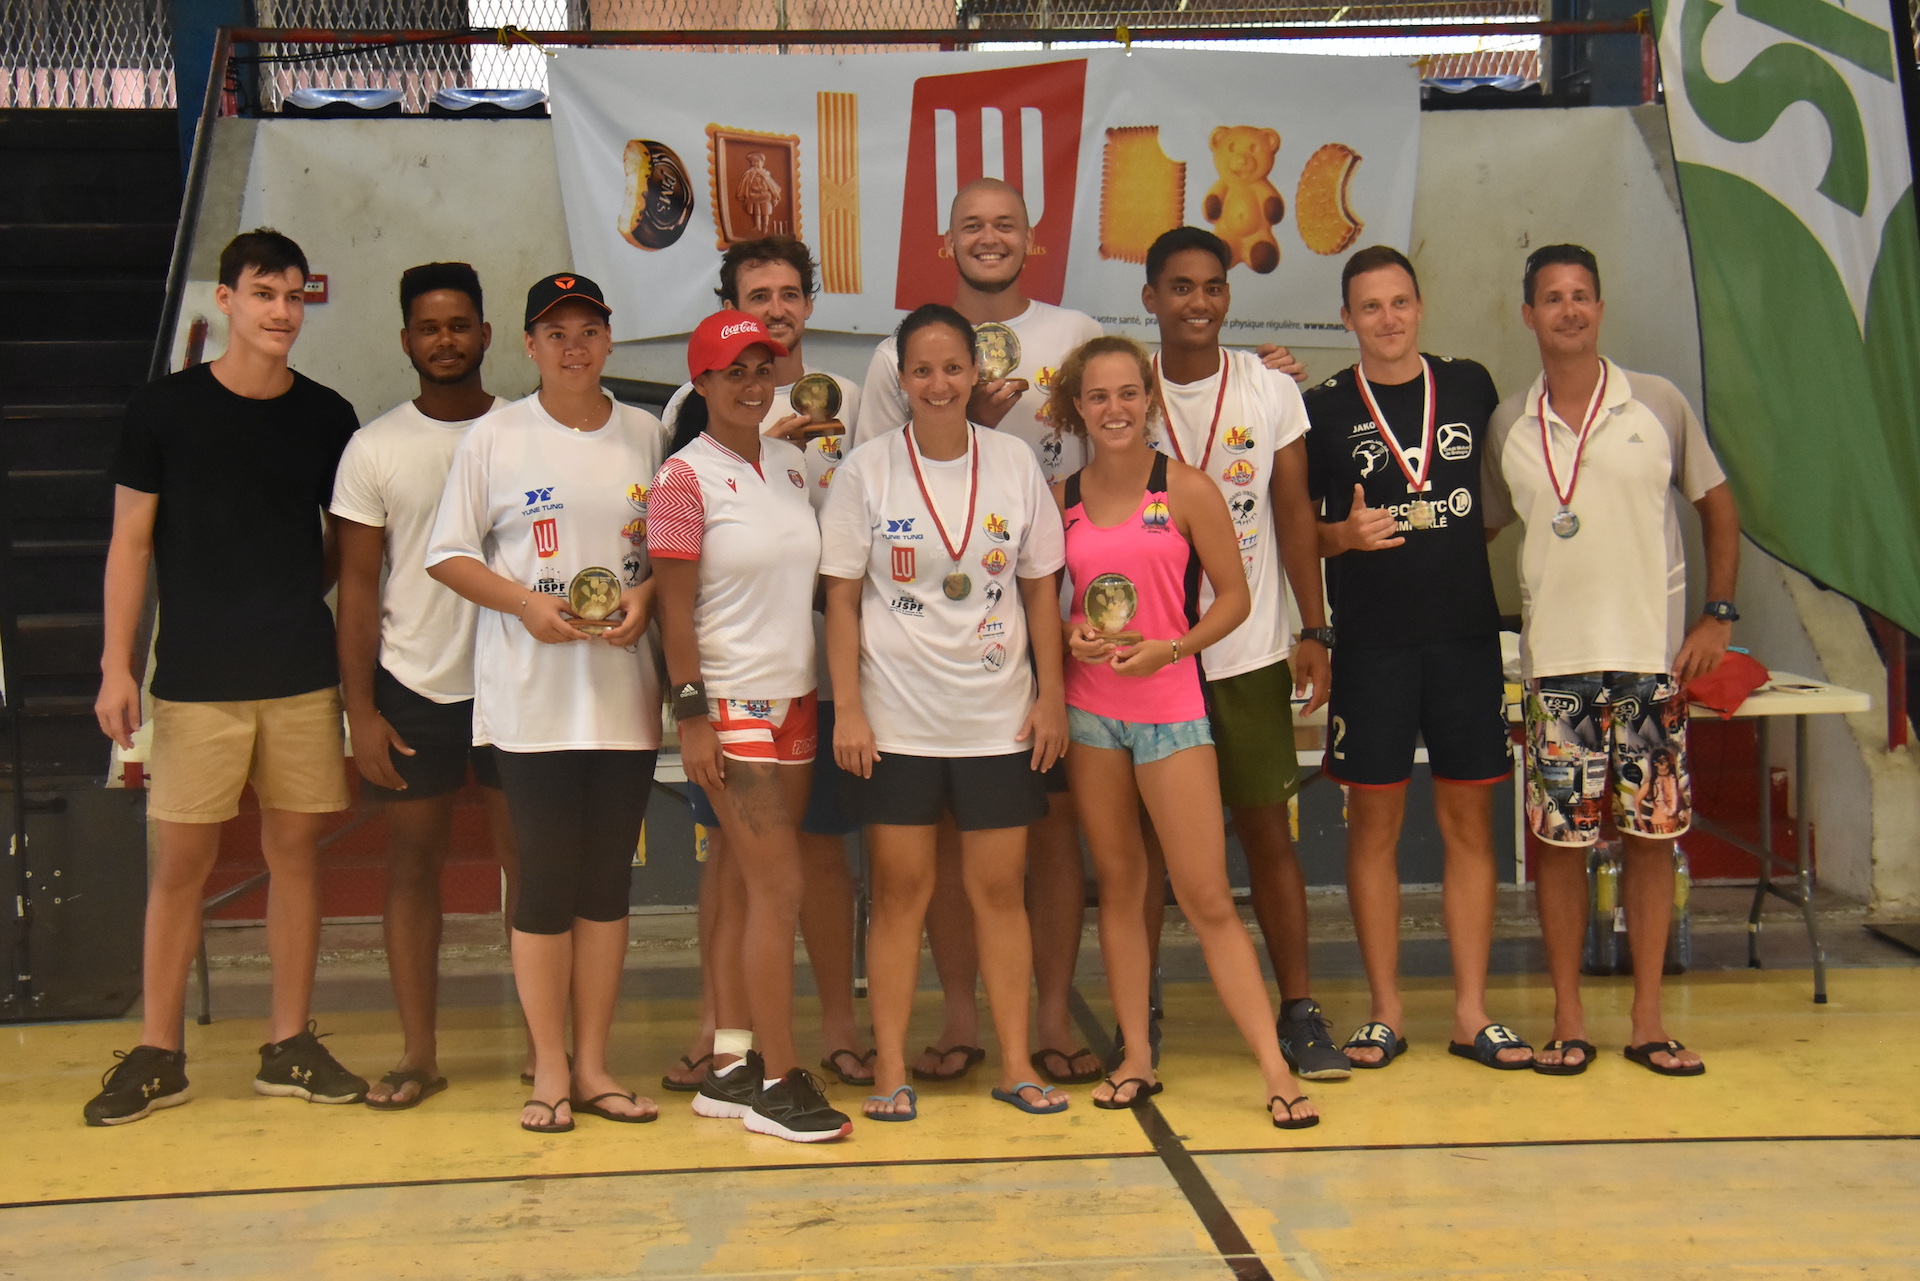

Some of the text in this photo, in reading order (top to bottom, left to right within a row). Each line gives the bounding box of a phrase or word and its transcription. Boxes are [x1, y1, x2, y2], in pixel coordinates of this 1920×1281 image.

[721, 320, 760, 340] Coca-Cola
[1229, 319, 1265, 329] physique
[1352, 421, 1376, 433] JAKO
[521, 503, 564, 517] YUNE TUNG
[535, 522, 555, 552] LU
[893, 550, 913, 578] LU
[1332, 714, 1347, 761] 2
